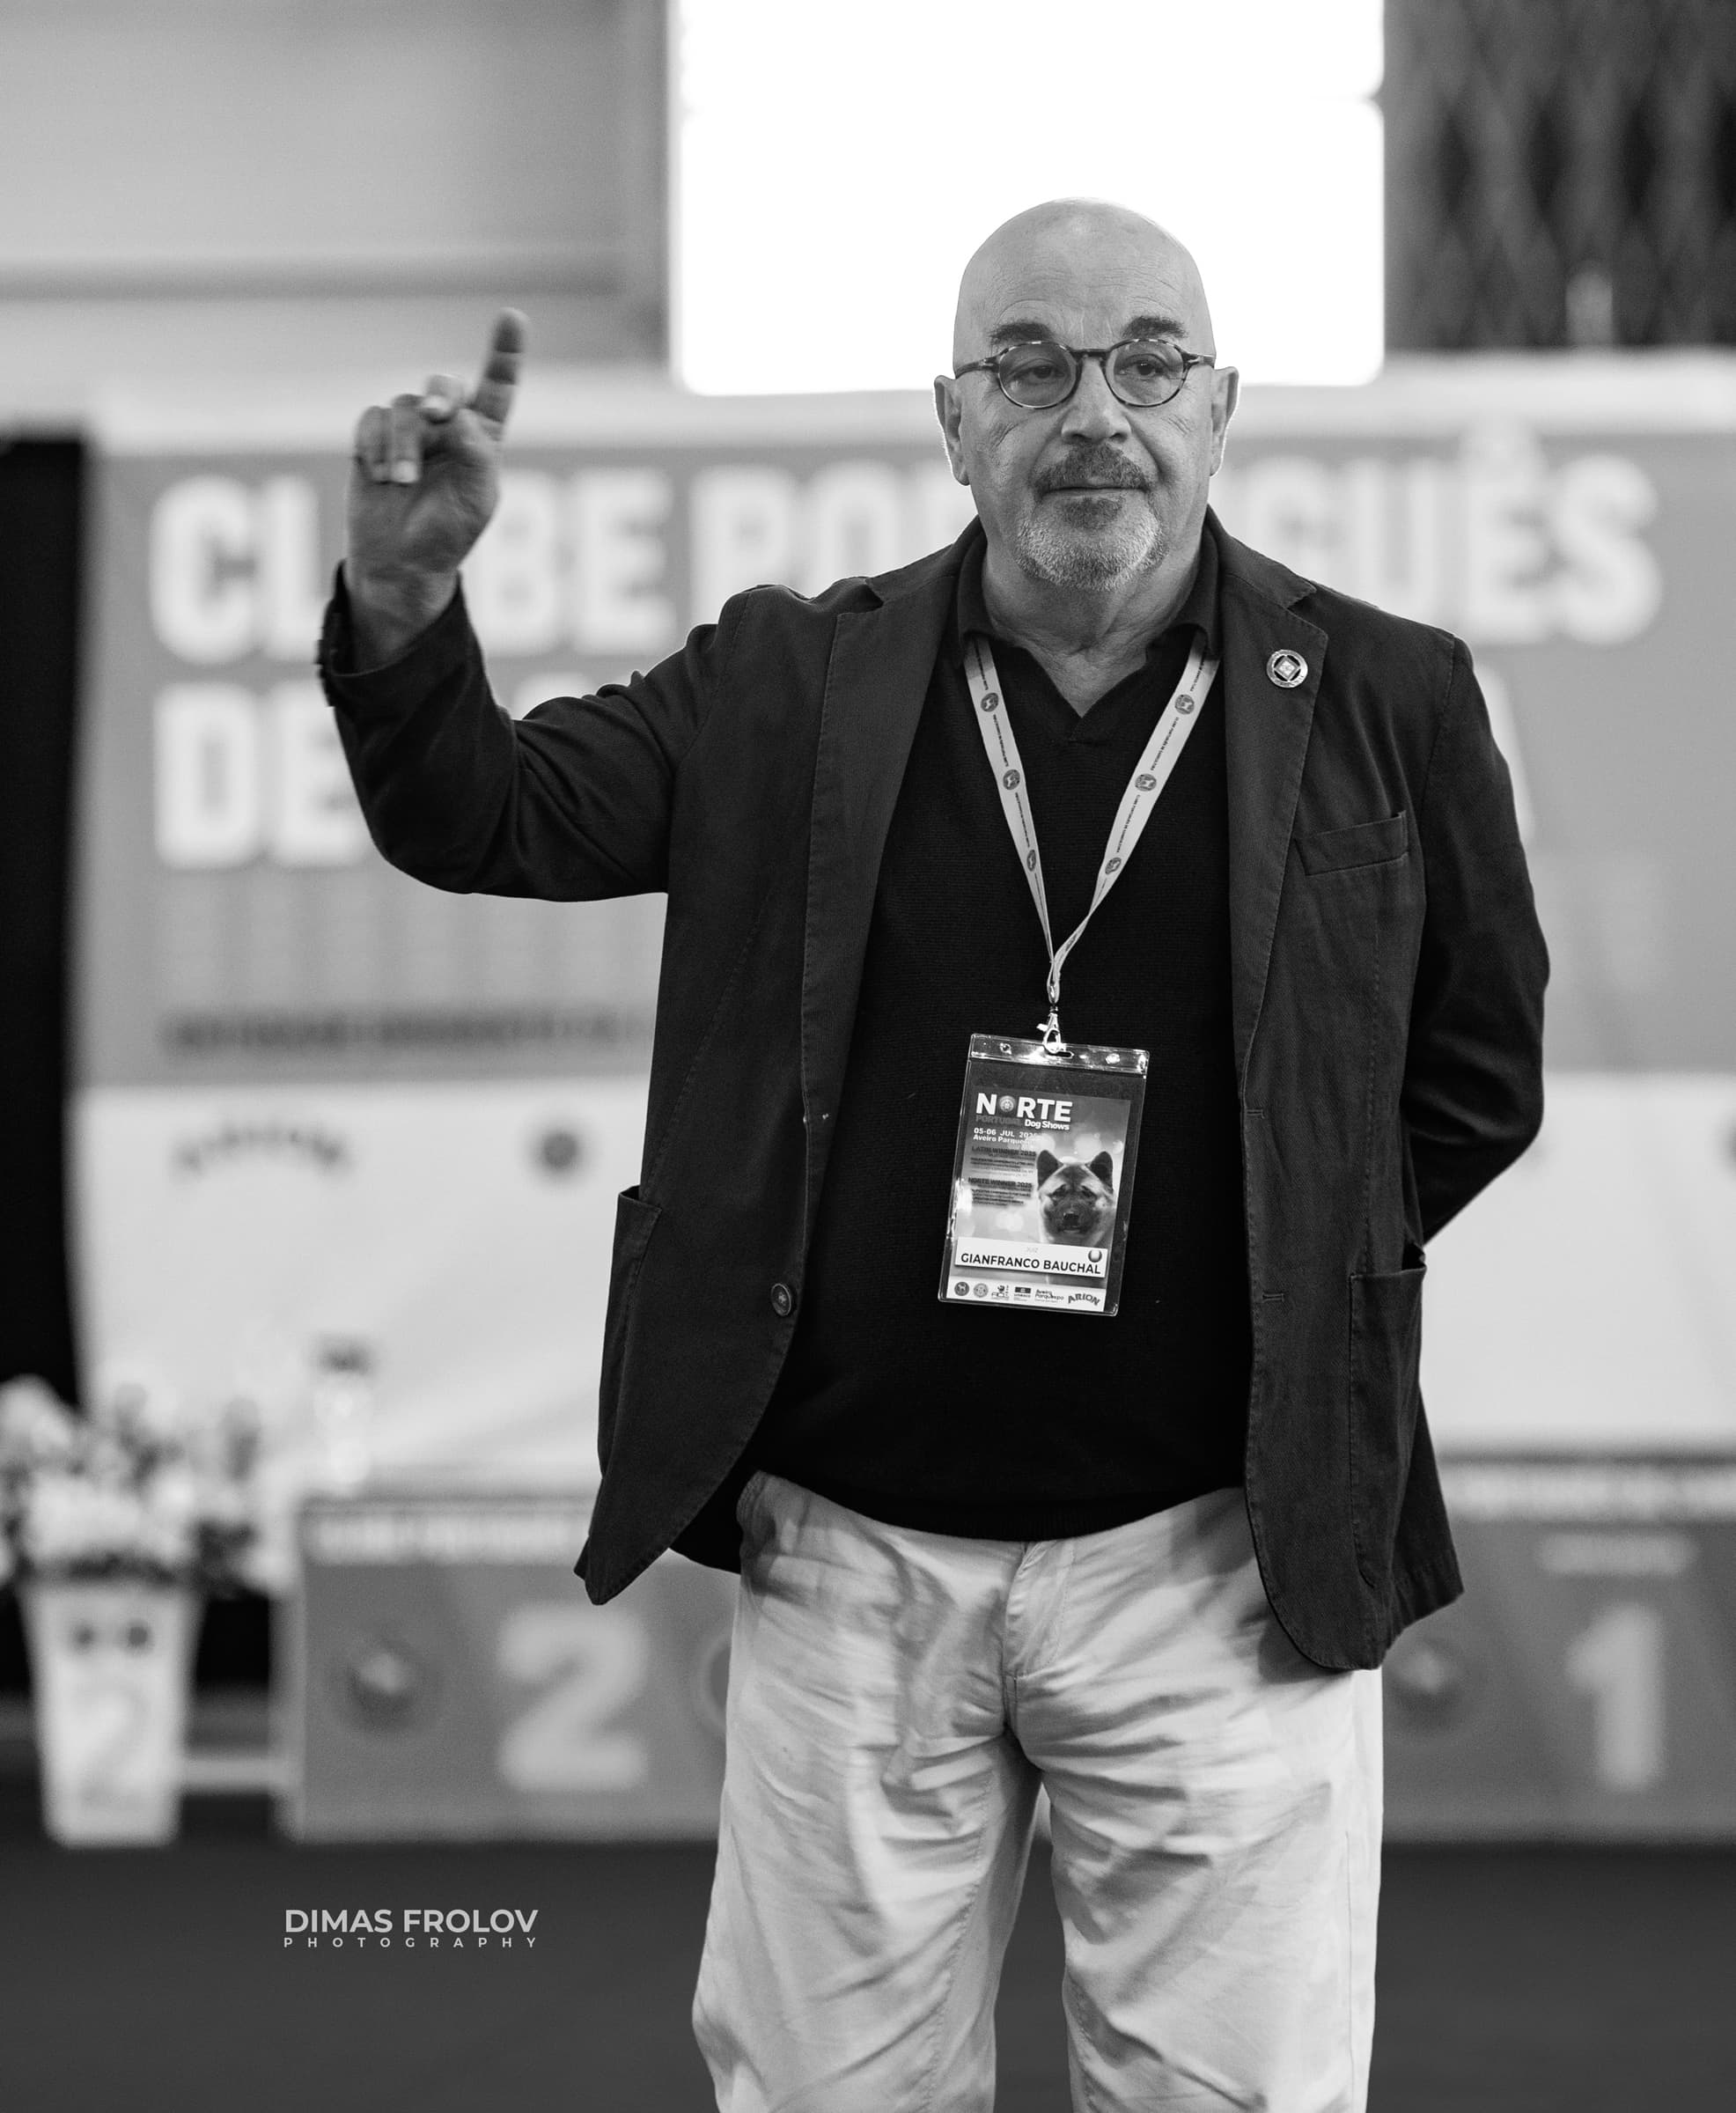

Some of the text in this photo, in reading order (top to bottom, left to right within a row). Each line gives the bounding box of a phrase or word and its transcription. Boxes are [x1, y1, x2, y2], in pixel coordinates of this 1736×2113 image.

[151, 416, 1662, 662] CLBE POGUÊS
[1025, 1119, 1070, 1130] Dog Shows
[973, 1134, 997, 1143] Aveiro
[960, 1253, 1101, 1274] GIANFRANCO BAUCHAL
[1068, 1293, 1100, 1306] ARION
[498, 1602, 650, 1793] 2
[1566, 1602, 1662, 1792] 1
